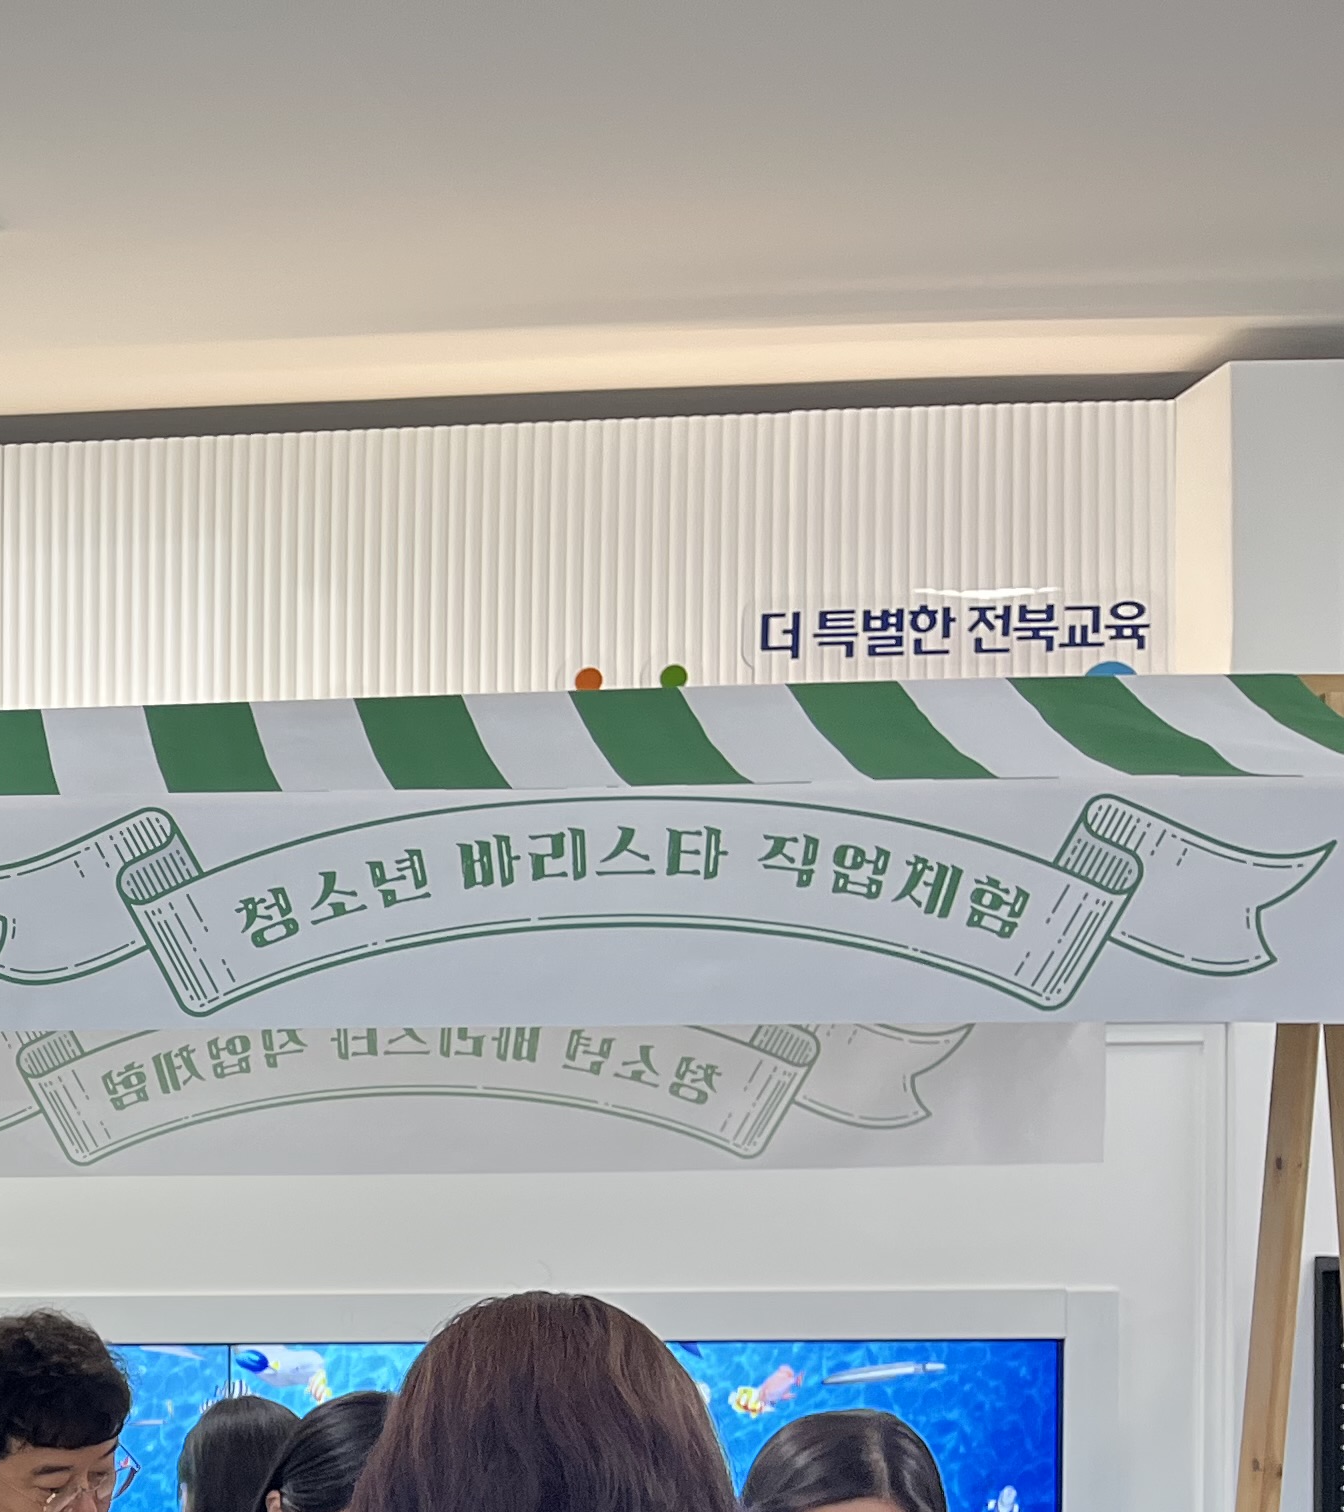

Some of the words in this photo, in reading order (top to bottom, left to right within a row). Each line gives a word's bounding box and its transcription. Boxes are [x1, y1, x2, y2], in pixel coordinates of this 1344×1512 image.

[761, 612, 801, 660] 더
[812, 604, 957, 658] 특별한
[967, 601, 1151, 655] 전북교육
[234, 847, 433, 949] 청소년
[456, 825, 729, 890] 바리스타
[758, 832, 1032, 940] 직업체험
